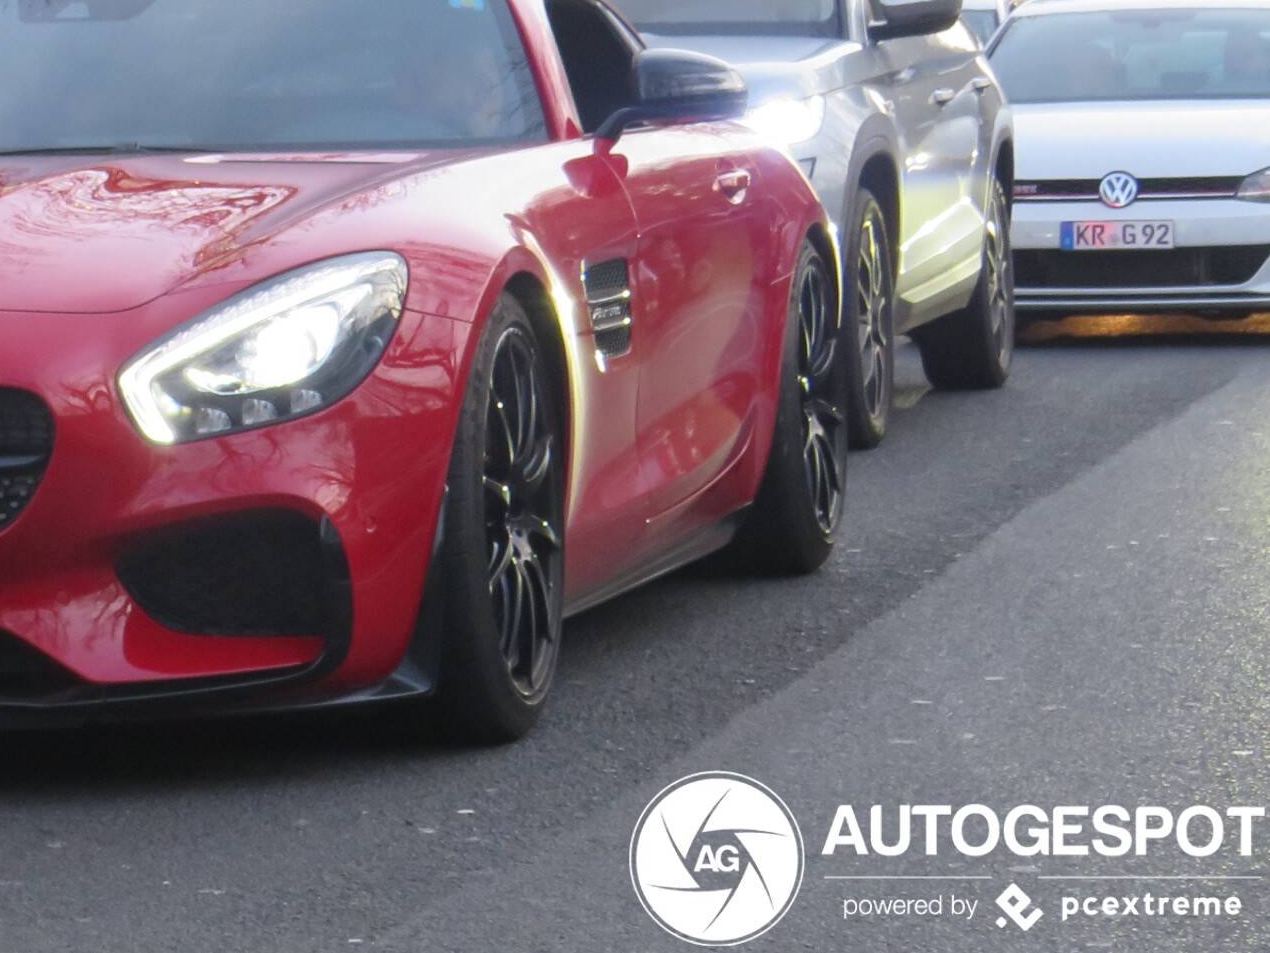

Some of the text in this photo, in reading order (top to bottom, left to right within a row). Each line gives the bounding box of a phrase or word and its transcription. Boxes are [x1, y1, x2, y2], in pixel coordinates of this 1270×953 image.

[1076, 223, 1170, 246] KR G 92
